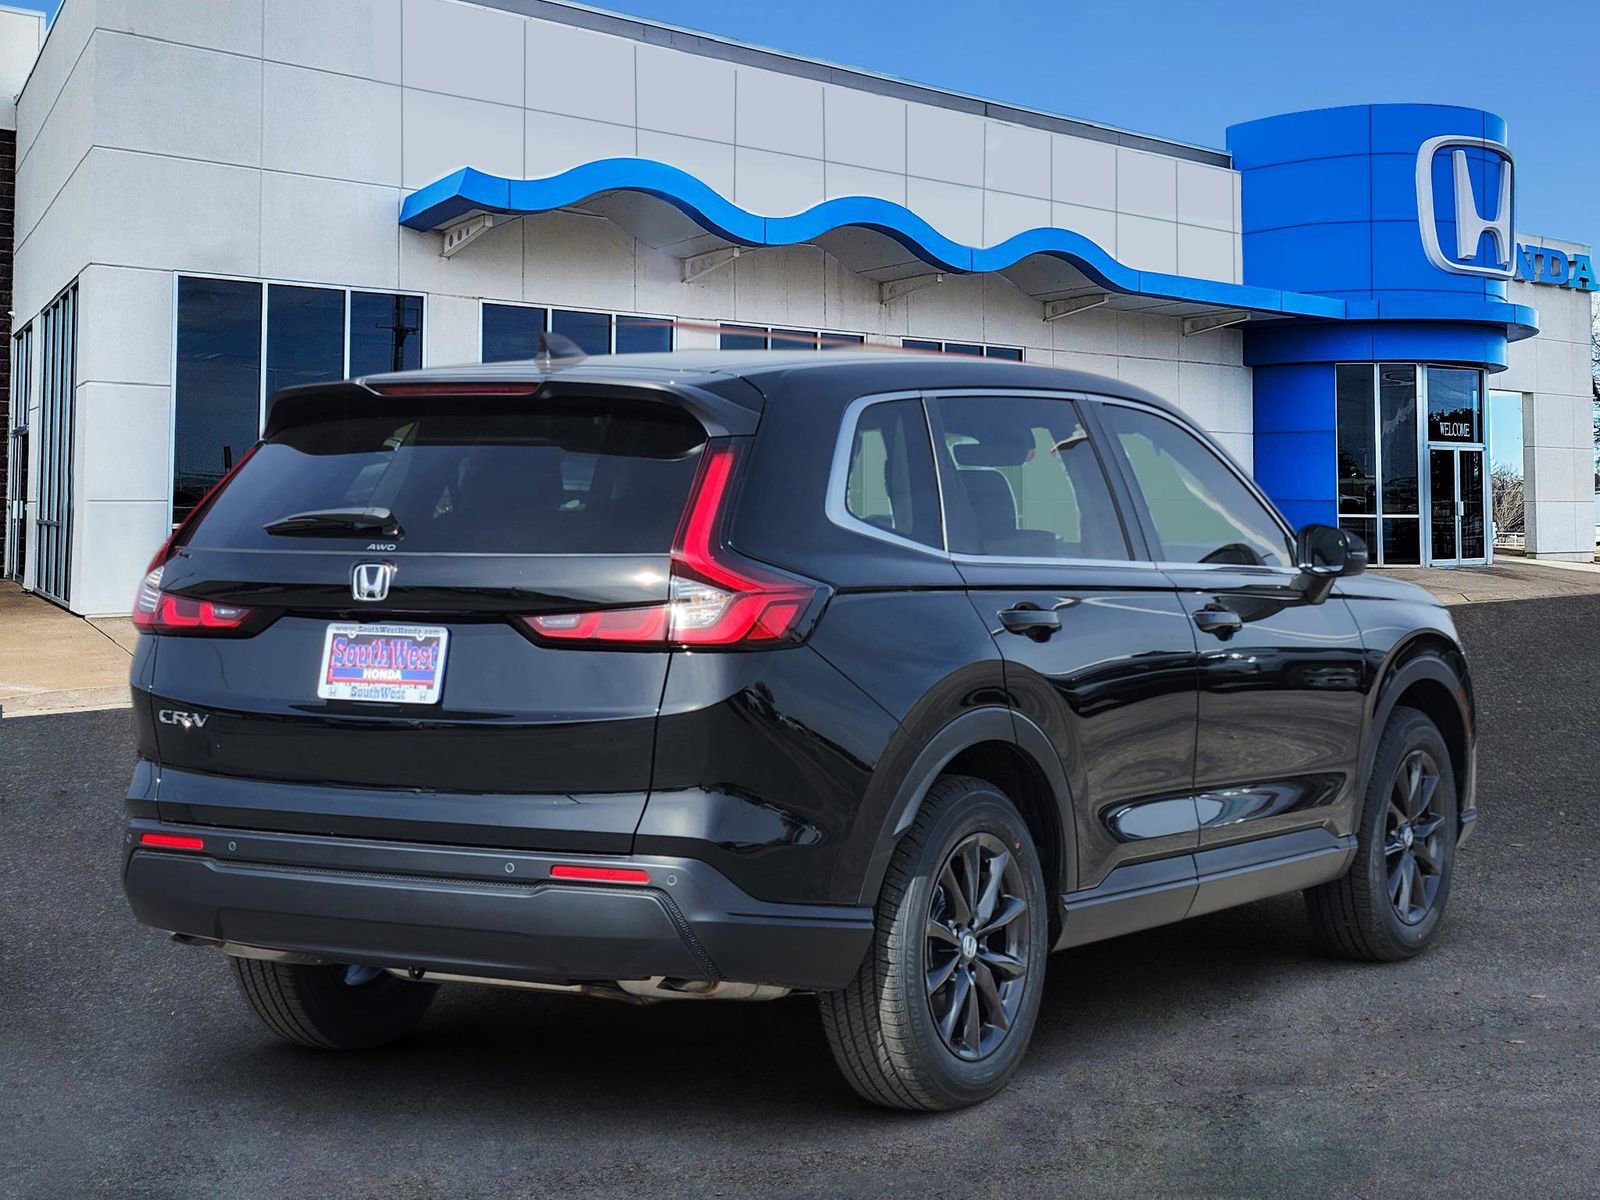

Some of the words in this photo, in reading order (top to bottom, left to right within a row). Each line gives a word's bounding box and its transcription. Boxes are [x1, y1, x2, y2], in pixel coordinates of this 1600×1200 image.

[1440, 422, 1470, 437] WELCOME
[366, 543, 396, 551] AWD
[363, 668, 402, 681] HONDA
